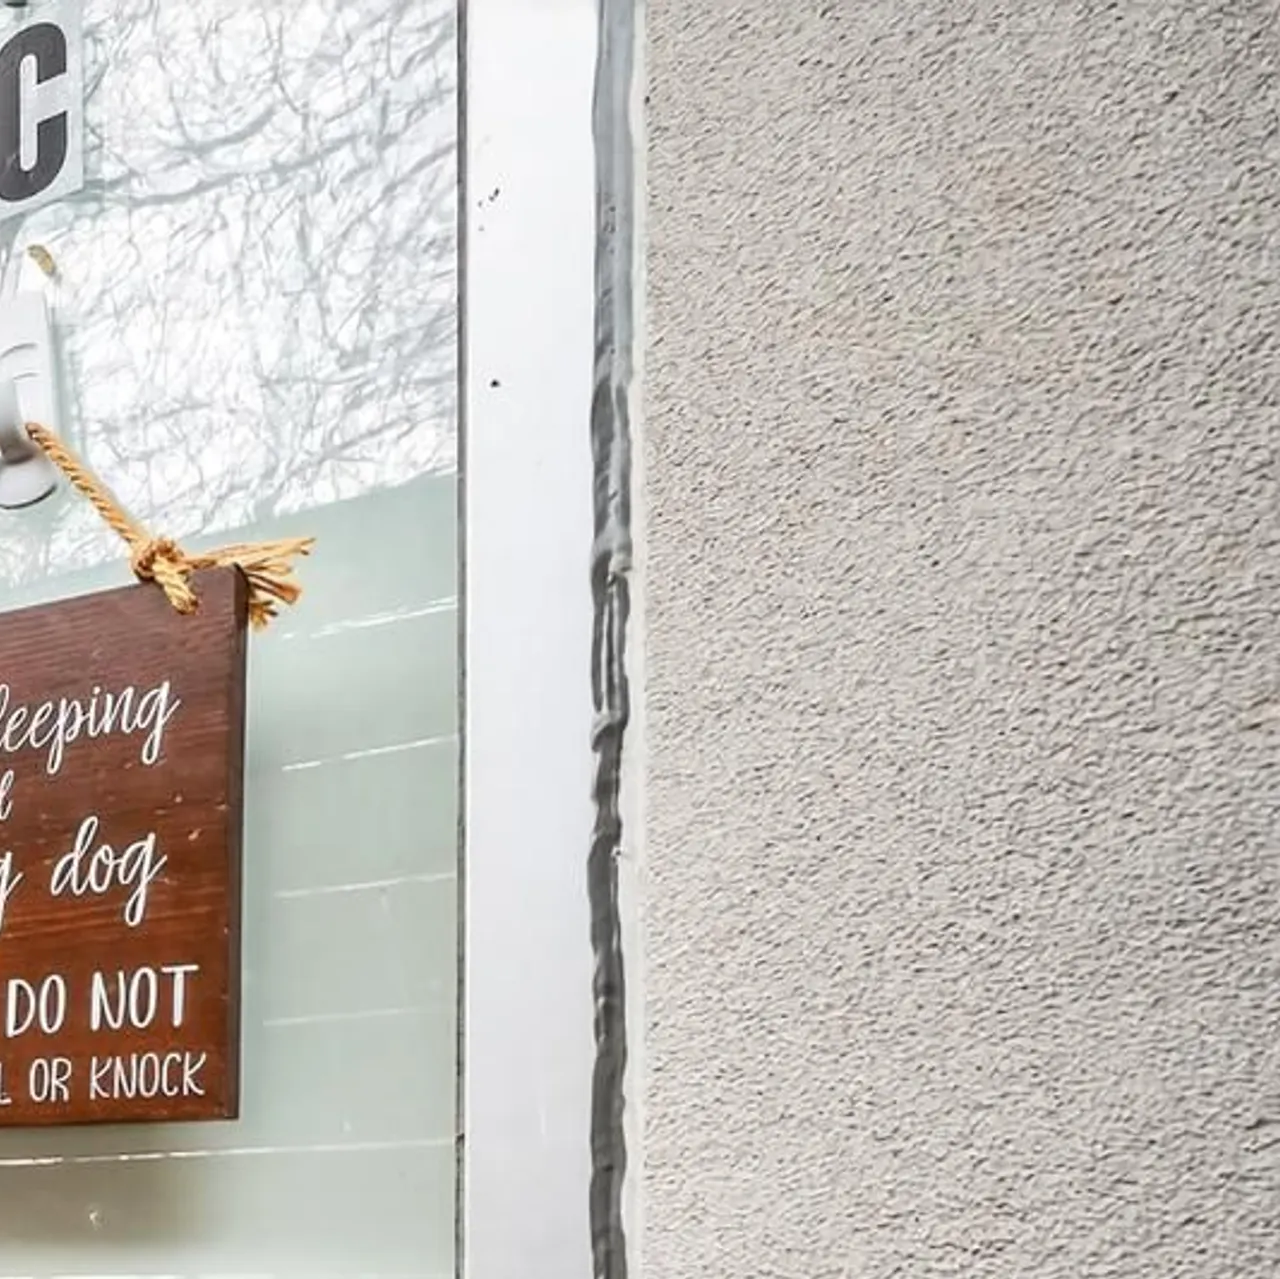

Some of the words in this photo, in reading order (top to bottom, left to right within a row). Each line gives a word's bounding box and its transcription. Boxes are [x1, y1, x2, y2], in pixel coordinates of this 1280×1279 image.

[50, 816, 168, 926] dog
[5, 974, 67, 1038] DO
[90, 964, 200, 1031] NOT
[29, 1058, 72, 1101] OR
[90, 1051, 208, 1100] KNOCK
